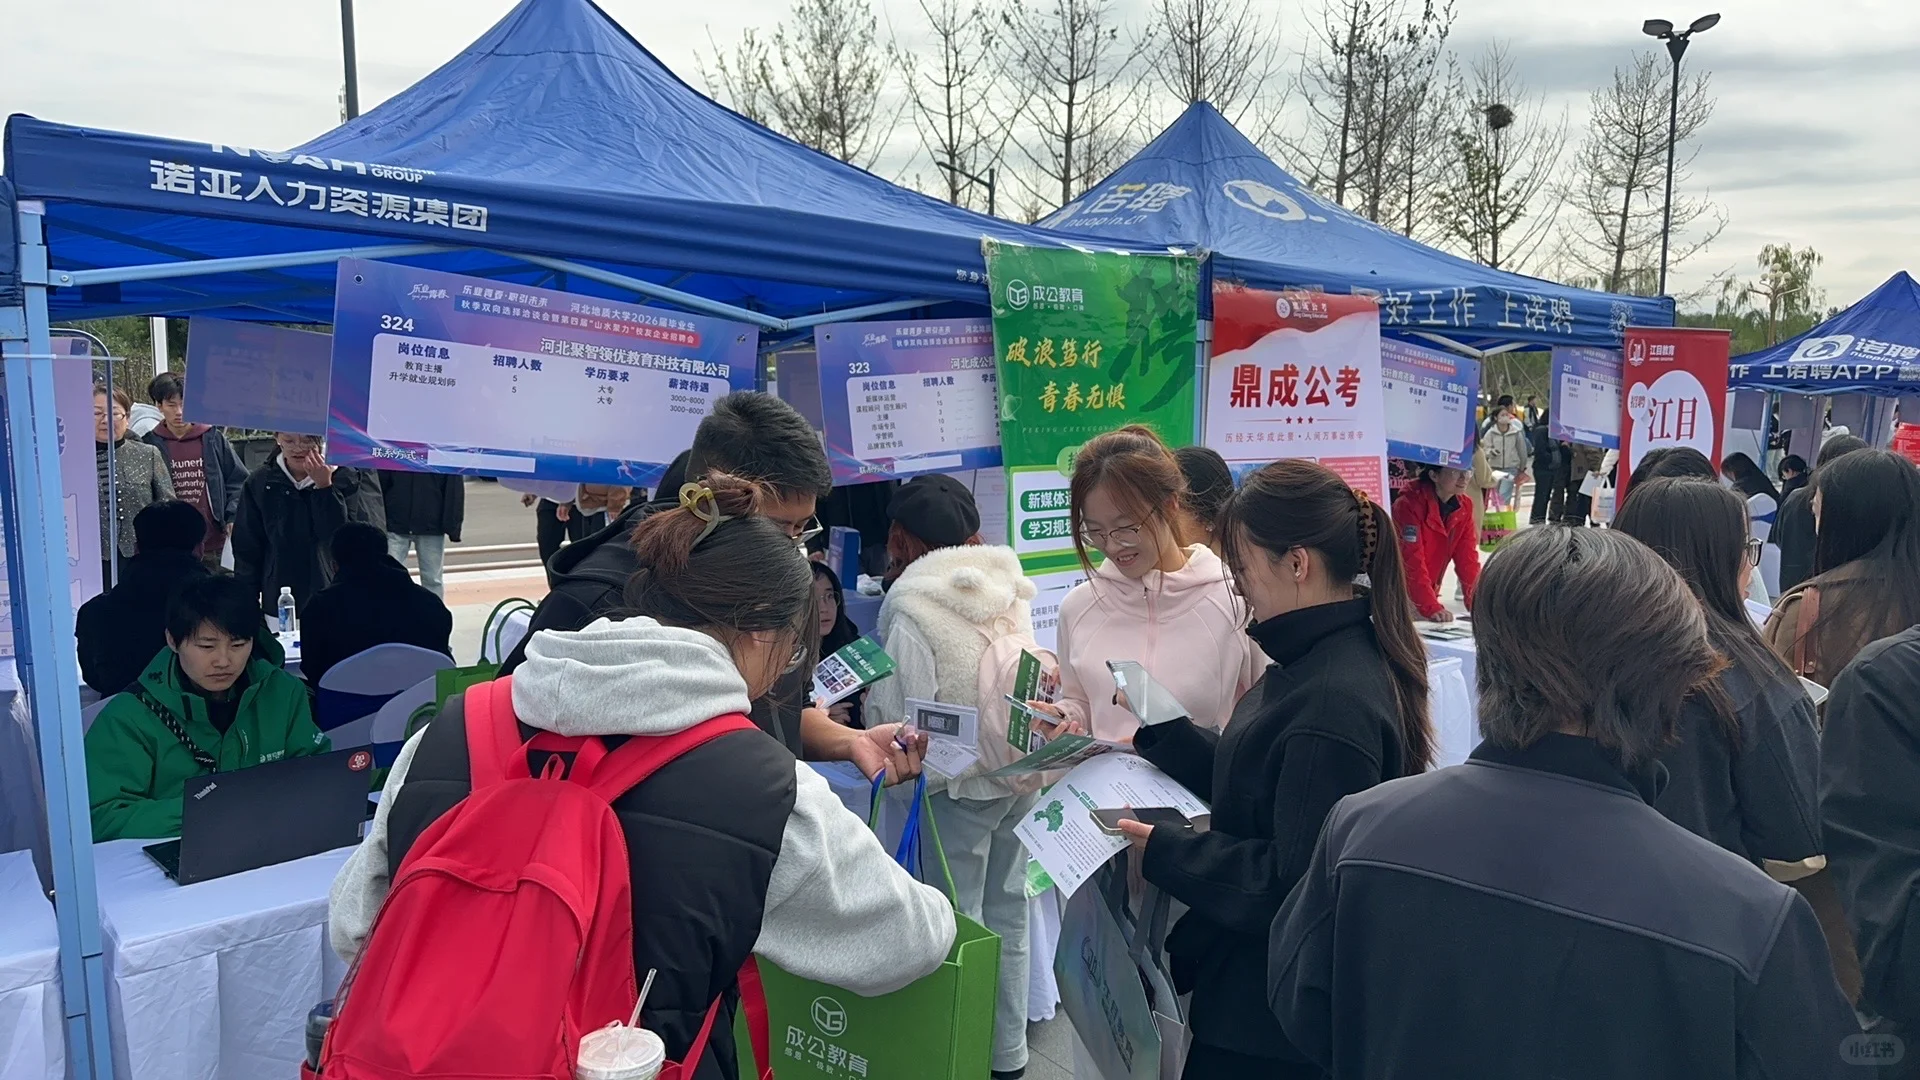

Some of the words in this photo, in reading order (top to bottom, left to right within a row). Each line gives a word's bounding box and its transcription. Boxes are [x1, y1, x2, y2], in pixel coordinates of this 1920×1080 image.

[371, 167, 424, 183] GROUP
[149, 159, 489, 233] 诺亚人力资源集团
[1033, 285, 1084, 303] 成公教育
[380, 314, 415, 332] 324
[570, 302, 696, 332] 河北地质大学2026届毕业生
[1385, 287, 1477, 328] 好工作
[1497, 290, 1576, 335] 上诺聘
[541, 337, 730, 379] 河北聚智领优教育科技有限公司
[1005, 335, 1103, 368] 破浪笃行
[1649, 344, 1675, 356] 江目教育
[1850, 351, 1911, 366] nuopin.cn
[1855, 337, 1920, 360] 诺聘
[397, 341, 450, 360] 岗位信息
[492, 354, 543, 372] 招聘人数
[585, 366, 630, 383] 学历要求
[668, 377, 710, 393] 薪资待遇
[404, 360, 443, 373] 教育主播
[512, 374, 518, 382] 5
[597, 385, 614, 395] 大专
[670, 394, 705, 405] 3000-8000
[848, 362, 870, 374] 323
[1762, 364, 1894, 381] 上诺聘APP
[388, 371, 457, 388] 升学就业规划师
[511, 386, 517, 394] 5
[597, 396, 613, 406] 大专
[669, 404, 704, 415] 3000-8000
[862, 380, 896, 392] 岗位信息
[923, 376, 954, 387] 招聘人数
[1038, 380, 1126, 413] 青春无惧
[1229, 363, 1361, 408] 鼎成公考
[1648, 397, 1698, 442] 江目
[194, 782, 217, 800] ThinkPad
[786, 1025, 869, 1077] 成公教育
